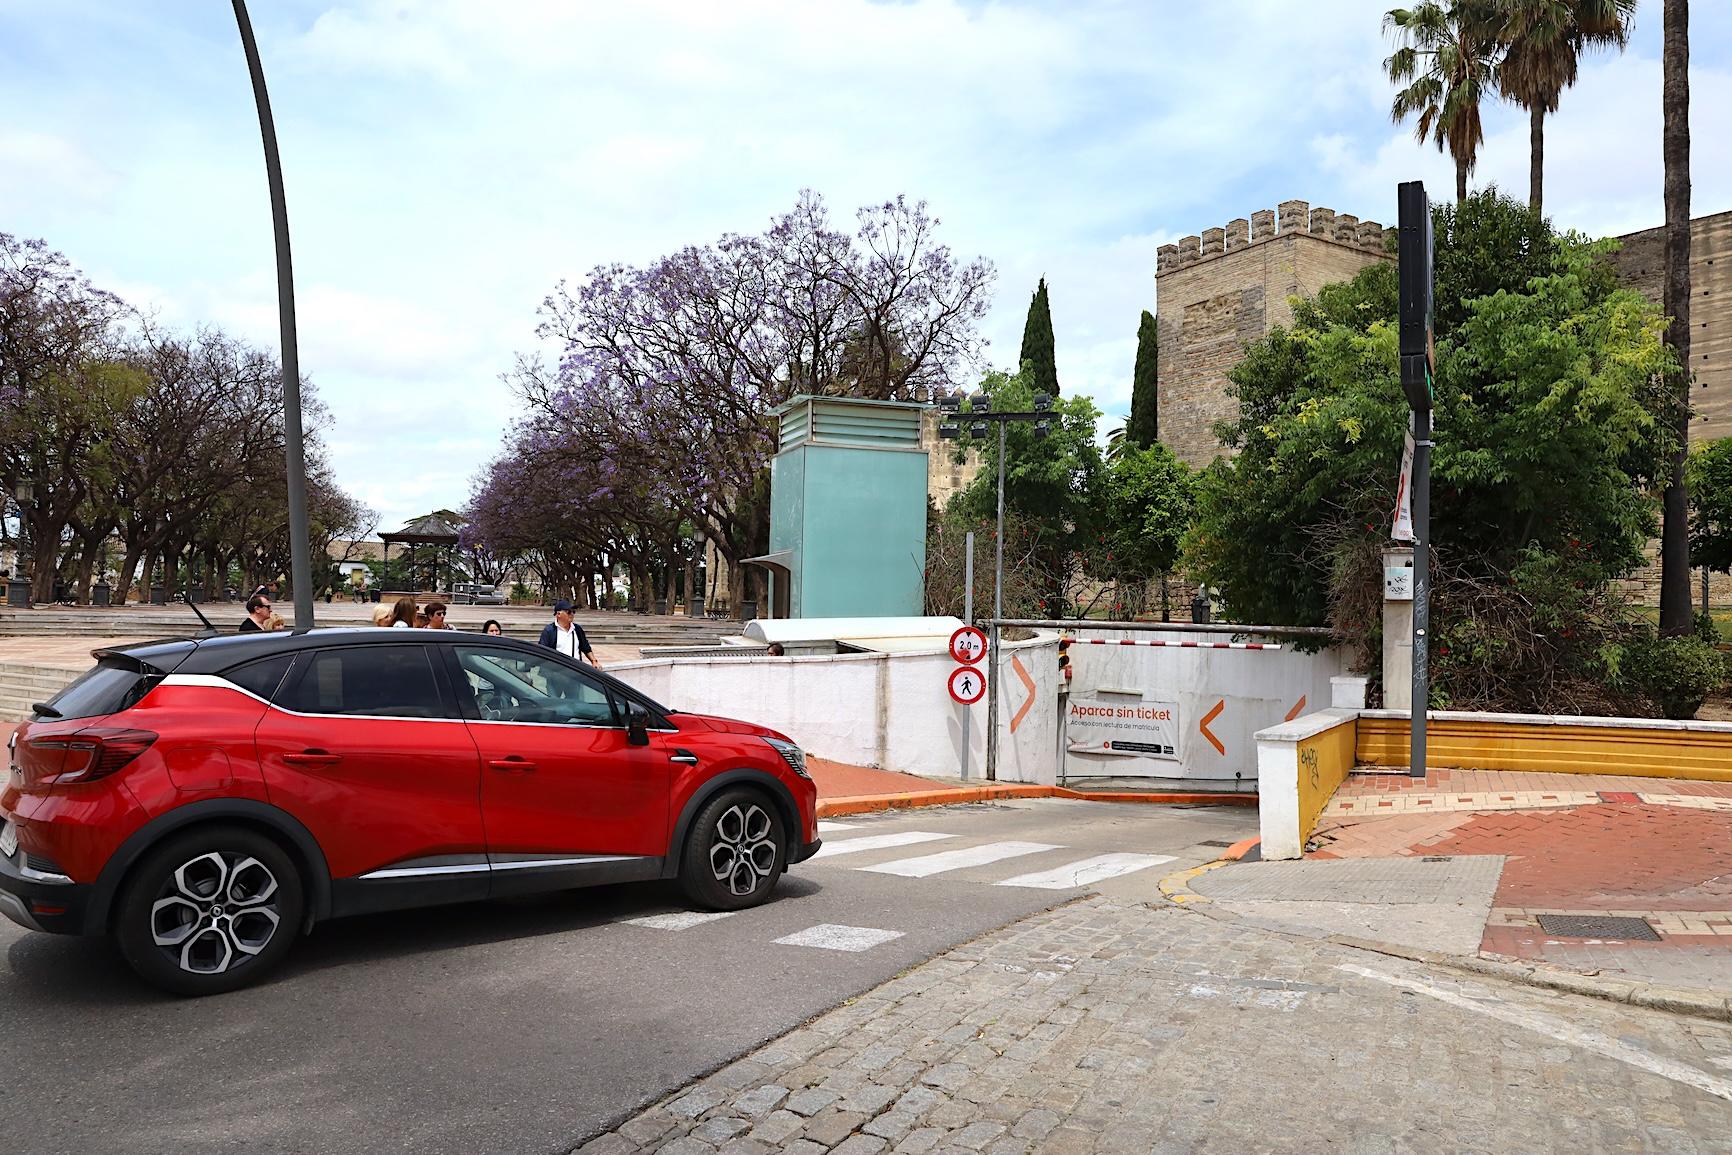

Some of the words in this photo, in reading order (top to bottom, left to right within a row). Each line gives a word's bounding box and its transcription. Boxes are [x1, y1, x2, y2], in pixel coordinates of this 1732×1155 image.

[1070, 705, 1114, 718] Aparca
[1116, 706, 1134, 718] sin
[1137, 707, 1170, 720] ticket
